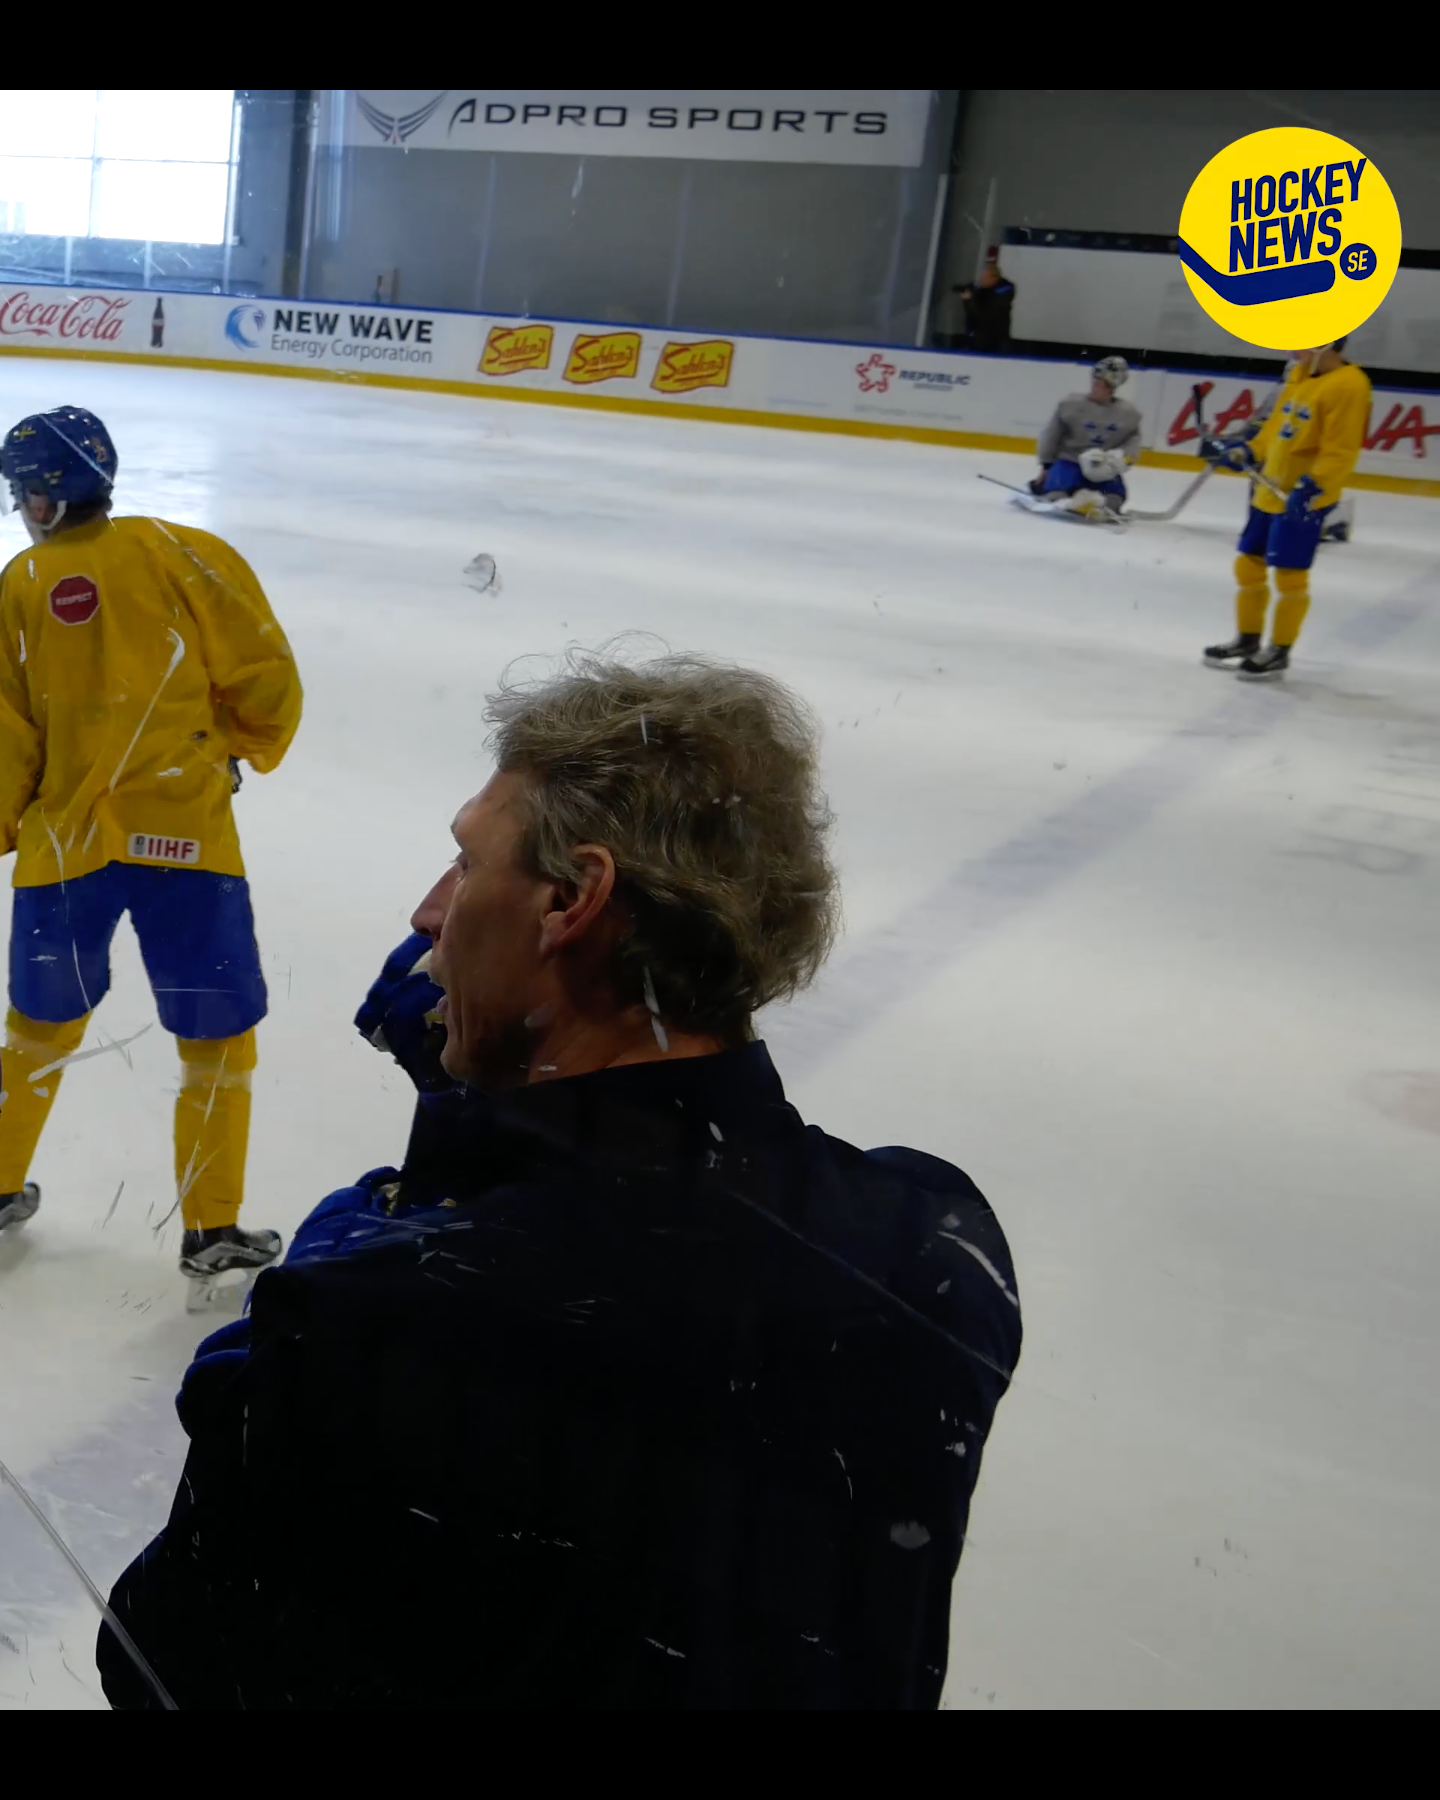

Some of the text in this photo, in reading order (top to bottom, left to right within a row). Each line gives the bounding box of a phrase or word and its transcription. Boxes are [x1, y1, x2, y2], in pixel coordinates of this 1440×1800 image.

[447, 98, 888, 138] ADPRO SPORTS
[274, 309, 433, 344] NEW WAVE
[271, 334, 433, 364] Energy Corporation
[899, 369, 971, 386] REPUBLIC
[148, 837, 195, 859] IIHF
